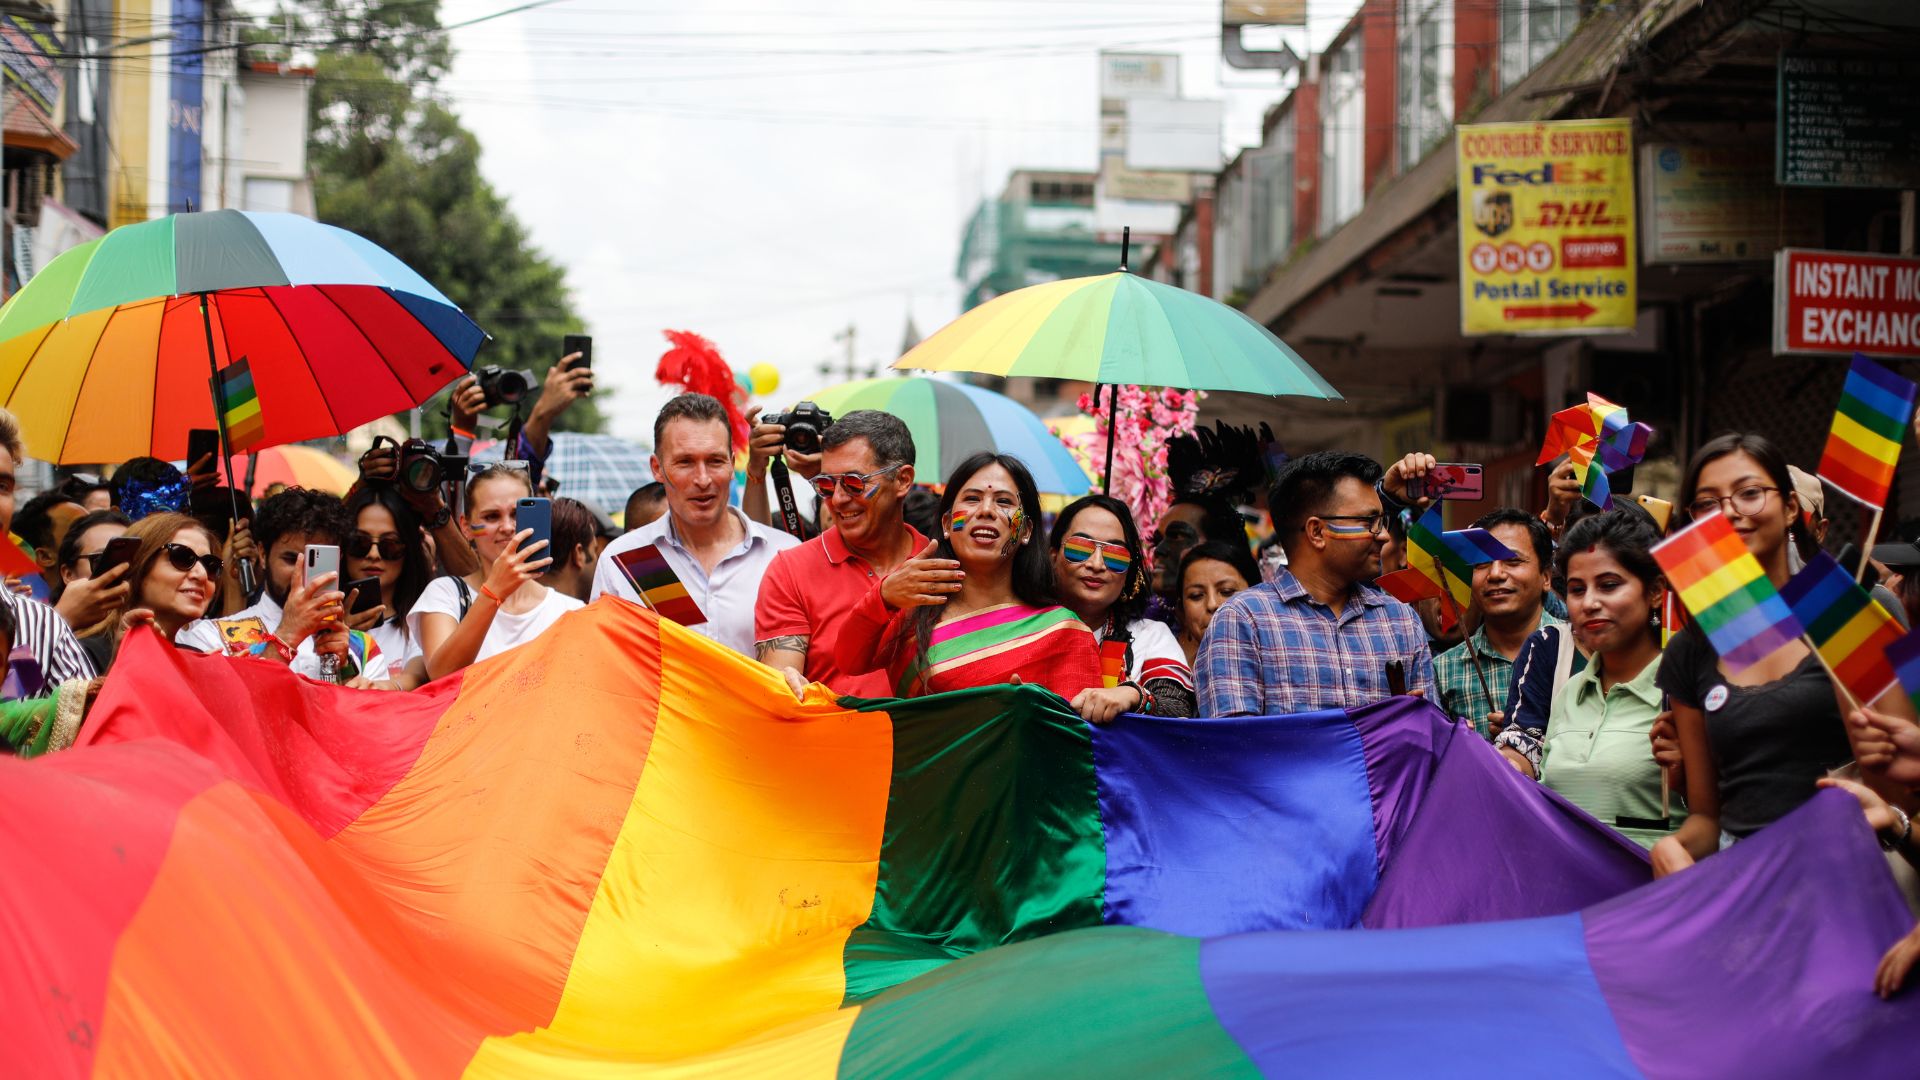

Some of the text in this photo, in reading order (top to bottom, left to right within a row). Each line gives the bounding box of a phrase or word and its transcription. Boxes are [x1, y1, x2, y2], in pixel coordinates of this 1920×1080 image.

[1463, 131, 1628, 158] COURIER SERVICE
[1472, 162, 1606, 185] FedEx
[1537, 200, 1614, 227] DHL
[1566, 242, 1619, 257] aramex
[1474, 277, 1627, 299] Postal Service
[1795, 261, 1890, 300] INSTANT
[780, 486, 794, 511] EOS
